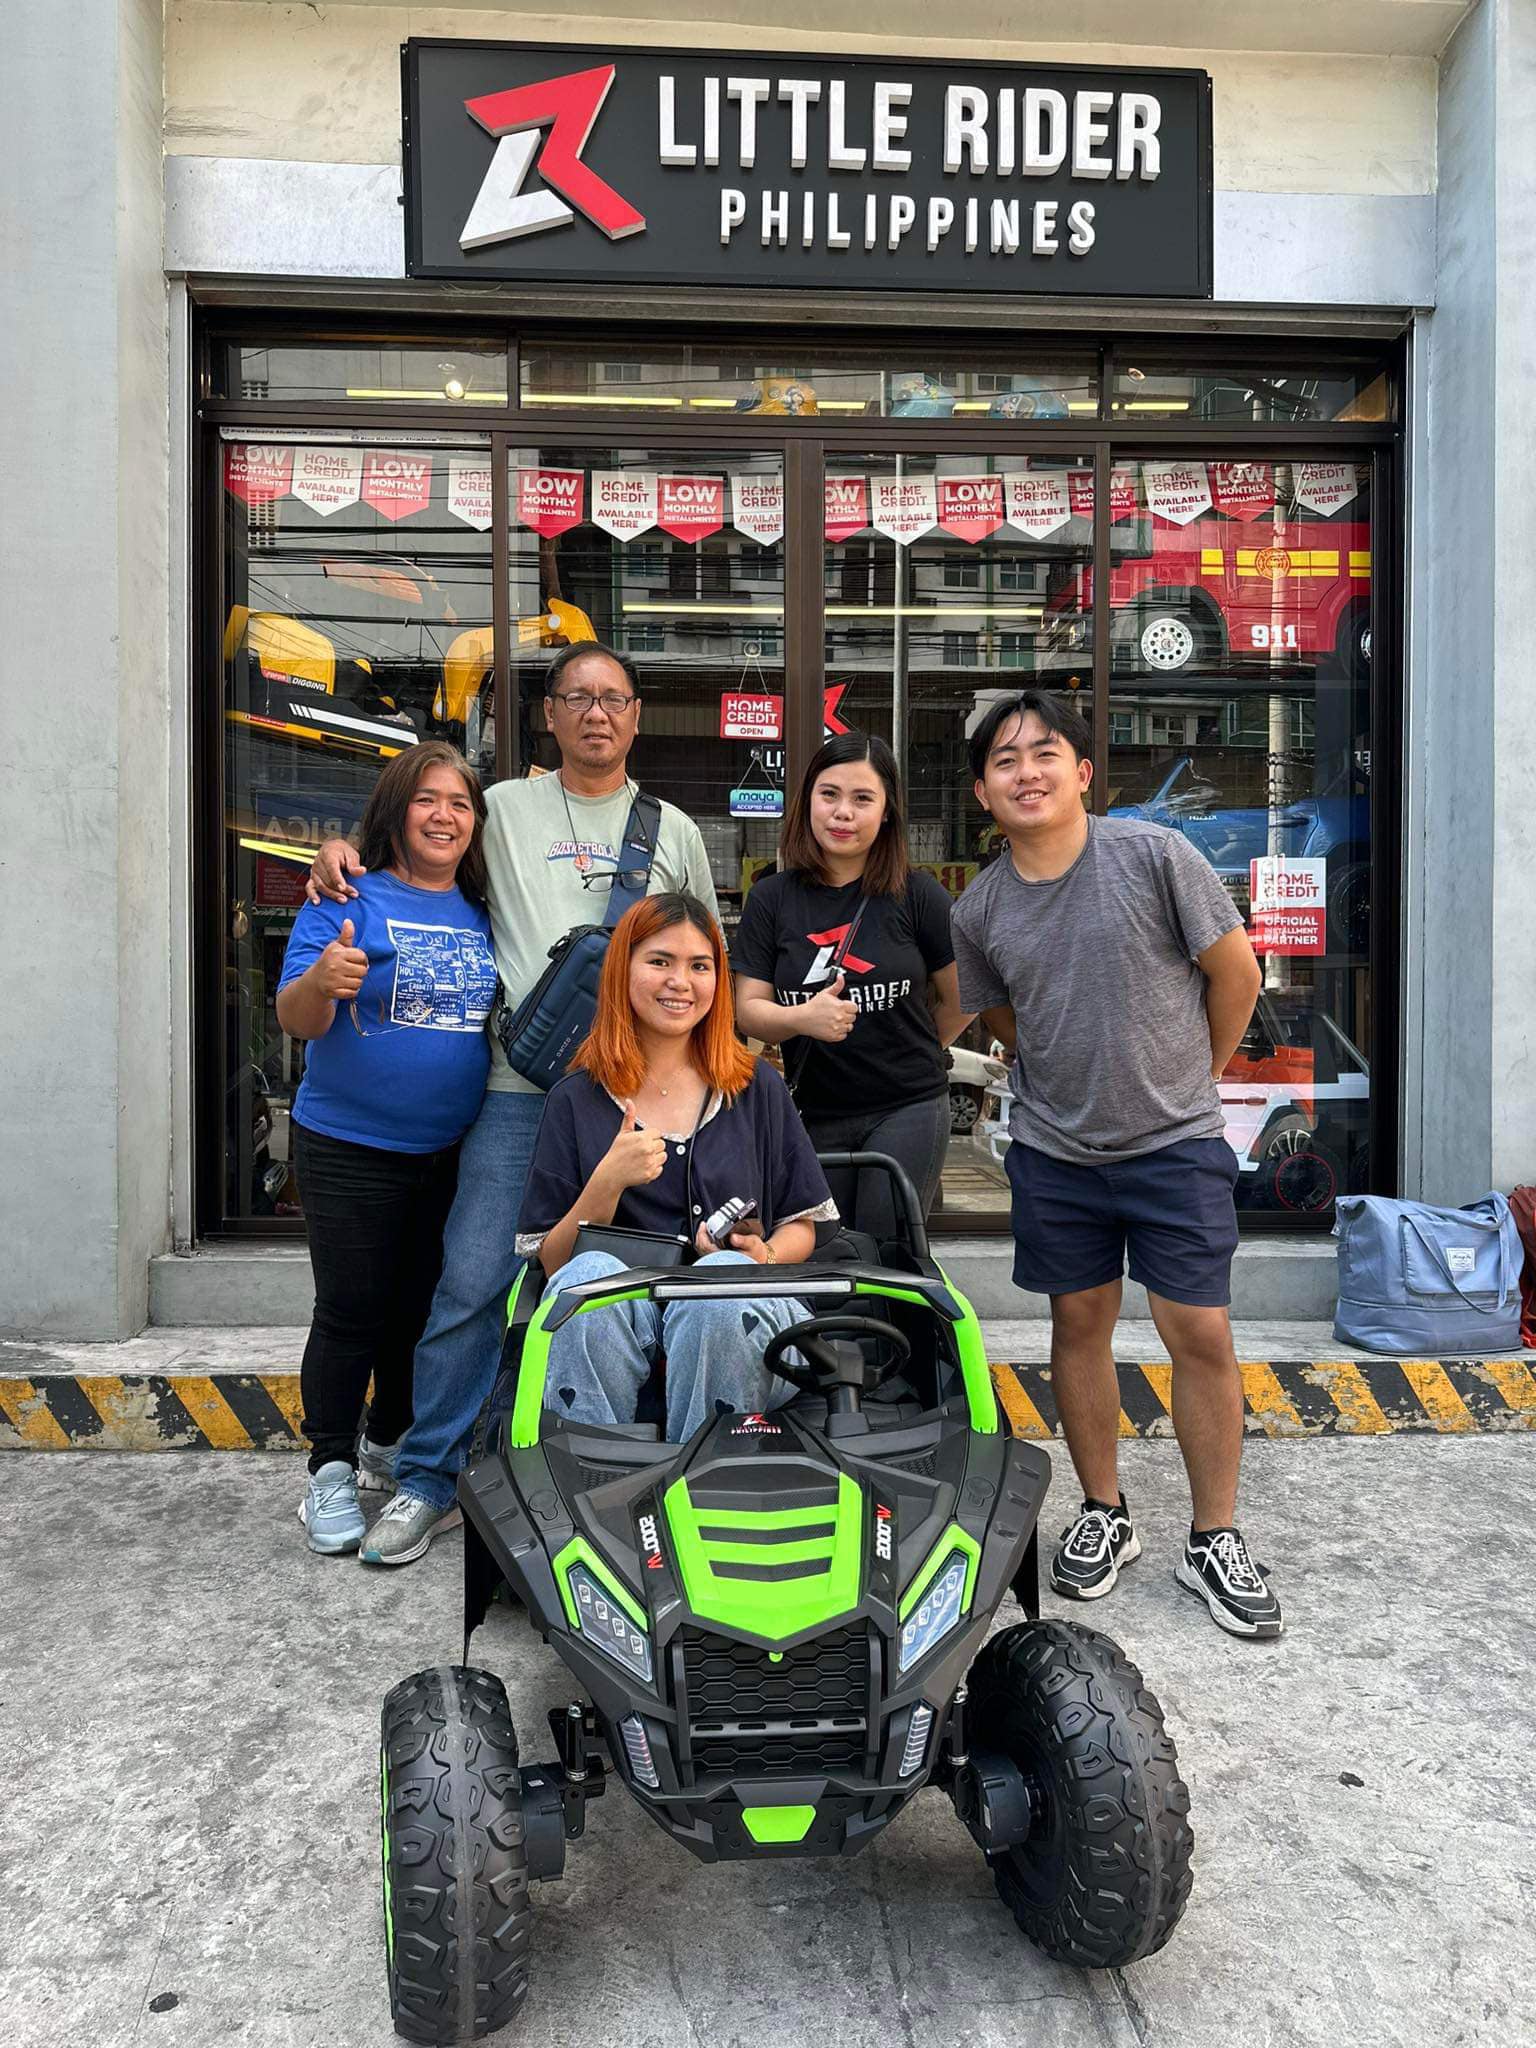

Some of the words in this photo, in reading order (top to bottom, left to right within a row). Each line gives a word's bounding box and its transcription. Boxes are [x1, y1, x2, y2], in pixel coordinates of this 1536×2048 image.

[658, 75, 913, 171] LITTLE
[943, 83, 1163, 183] RIDER
[719, 188, 1097, 256] PHILIPPINES
[231, 445, 288, 466] LOW
[304, 453, 349, 467] HOME
[230, 463, 285, 477] MONTHLY
[303, 464, 353, 479] CREDIT
[369, 458, 427, 480] LOW
[1215, 465, 1266, 486] LOW
[1301, 467, 1346, 481] CREDIT
[1152, 470, 1193, 483] HOME
[297, 481, 355, 495] AVAILABLE
[369, 478, 424, 492] MONTHLY
[523, 475, 578, 497] LOW
[601, 480, 644, 492] HOME
[880, 485, 922, 497] HOME
[1014, 480, 1055, 491] HOME
[1153, 480, 1200, 492] CREDIT
[1217, 483, 1268, 496] MONTHLY
[1300, 483, 1353, 497] AVAILABLE
[311, 493, 340, 504] HERE
[600, 491, 649, 504] CREDIT
[664, 484, 718, 503] LOW
[944, 484, 998, 502] LOW
[1014, 490, 1061, 502] CREDIT
[1314, 494, 1340, 505] HERE
[523, 495, 577, 508] MONTHLY
[880, 495, 928, 508] CREDIT
[1153, 494, 1207, 507] AVAILABLE
[597, 508, 653, 519] AVAILABLE
[663, 503, 718, 514] MONTHLY
[944, 503, 997, 513] MONTHLY
[1012, 506, 1066, 518] AVAILABLE
[1167, 504, 1195, 515] HERE
[611, 519, 639, 529] HERE
[878, 512, 933, 523] AVAILABLE
[1025, 517, 1053, 528] HERE
[753, 523, 782, 533] HERE
[892, 522, 920, 533] HERE
[1250, 624, 1298, 648] 911
[291, 676, 327, 691] DIGGING
[727, 700, 774, 712] HOME
[726, 711, 778, 724] CREDIT
[739, 727, 764, 736] OPEN
[738, 792, 775, 804] maya
[1263, 873, 1314, 885] HOME
[1263, 886, 1320, 898] CREDIT
[1263, 916, 1319, 926] OFFICIAL
[1263, 935, 1319, 945] PARTNER
[849, 979, 911, 1003] RIDER
